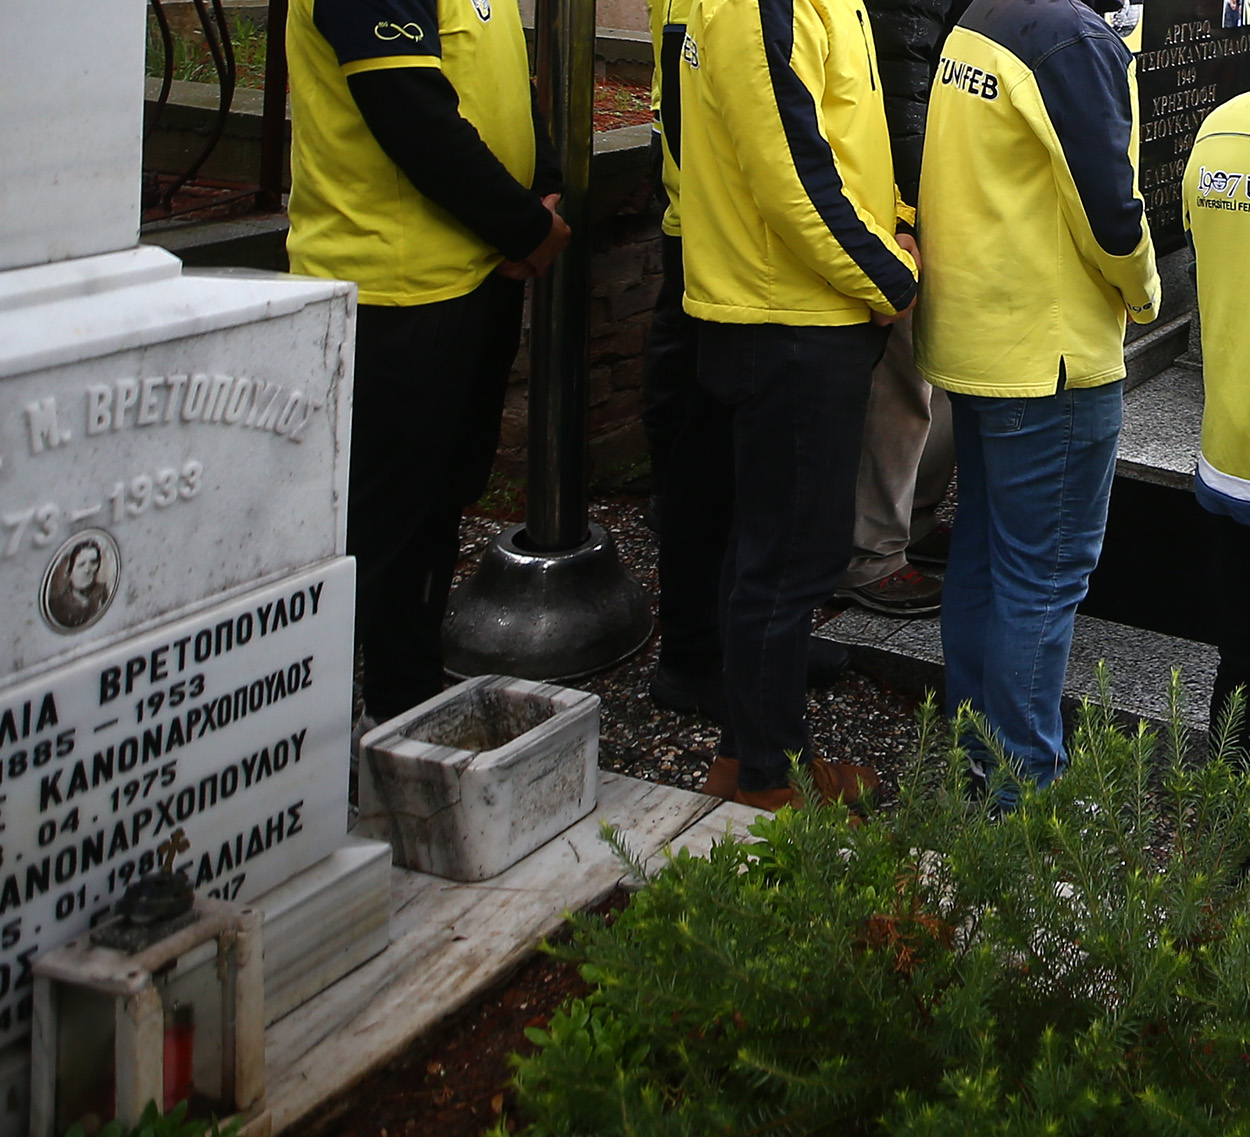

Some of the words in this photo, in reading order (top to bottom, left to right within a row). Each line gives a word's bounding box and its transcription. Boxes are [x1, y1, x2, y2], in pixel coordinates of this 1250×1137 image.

[109, 461, 204, 521] 1933
[99, 581, 325, 707] ΒΡΕΤΟΠΟΥΛΟΥ
[136, 673, 206, 723] 1953
[39, 656, 314, 813] ΚΑΝΟΝΑΡΧΟΠΟΥΛΟΣ
[110, 760, 178, 813] 1975
